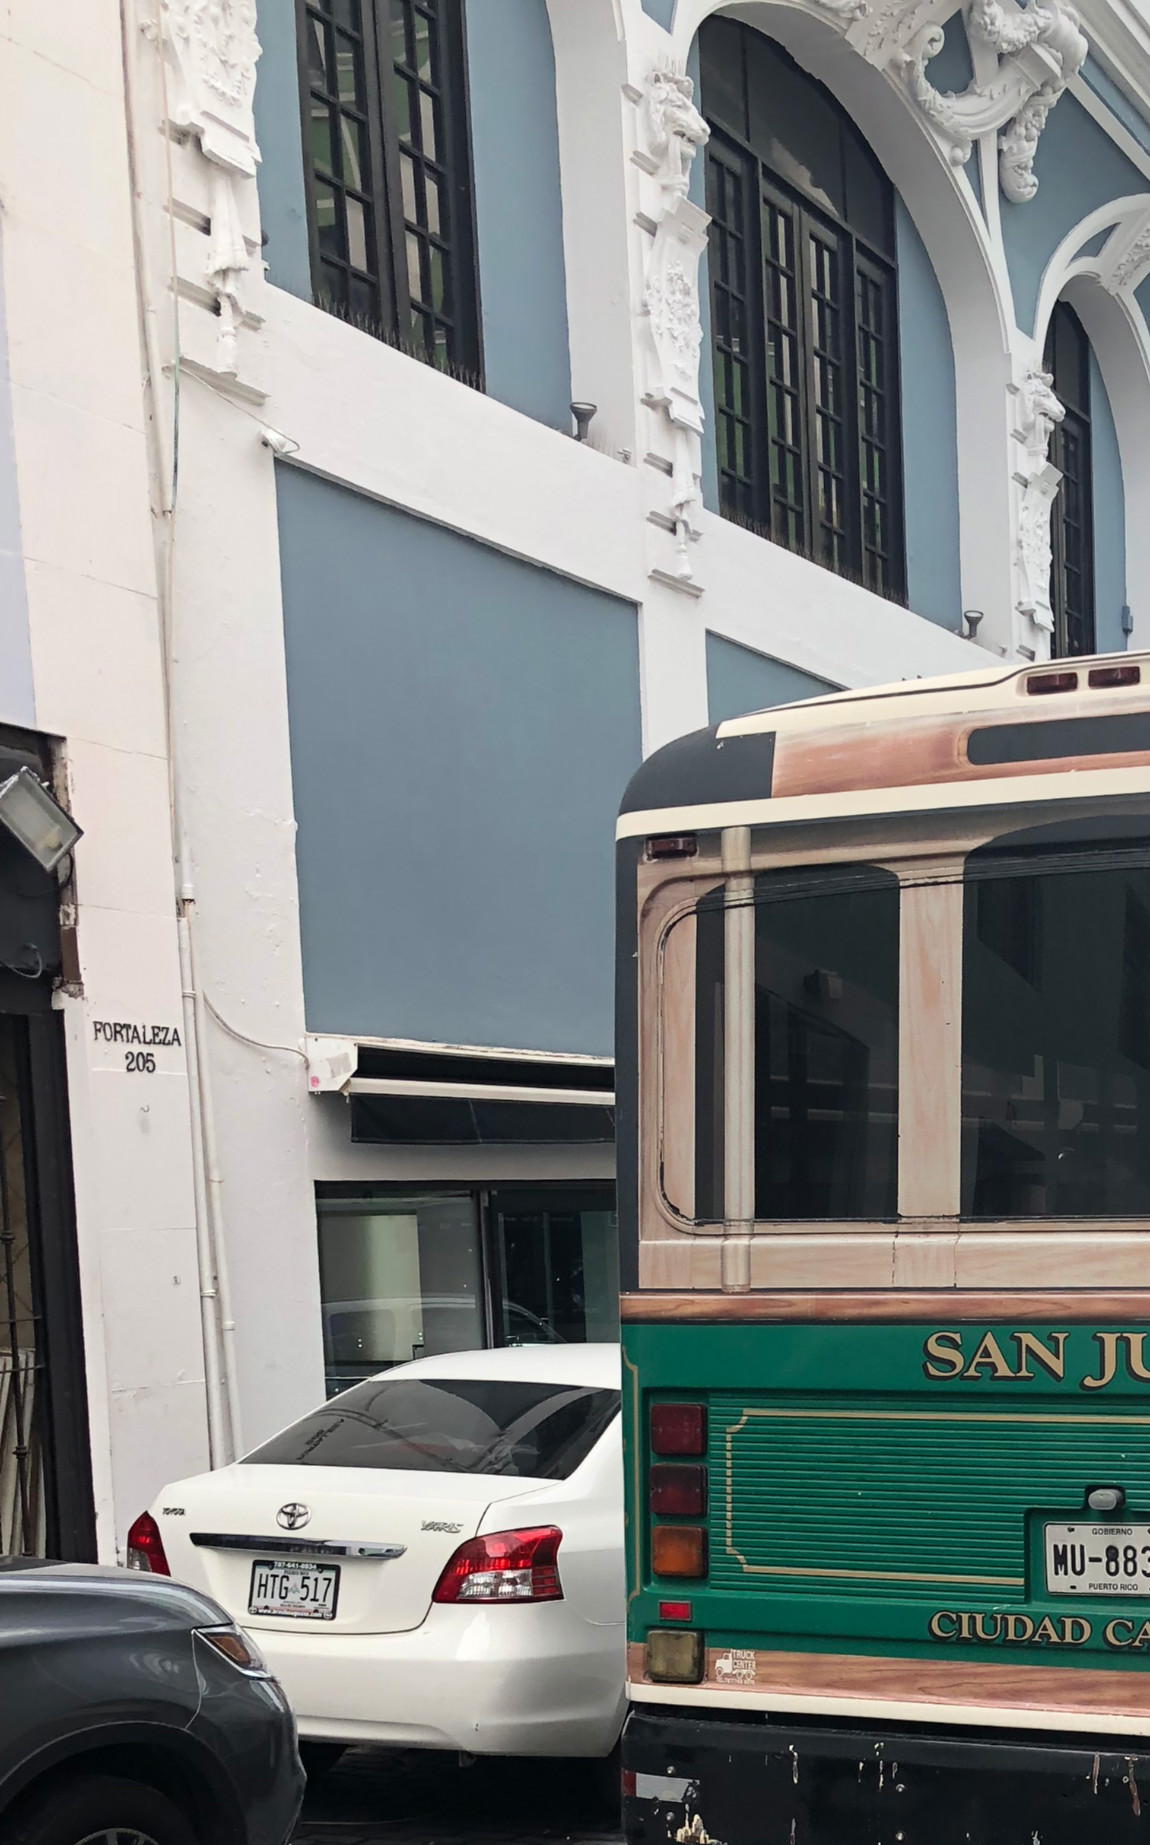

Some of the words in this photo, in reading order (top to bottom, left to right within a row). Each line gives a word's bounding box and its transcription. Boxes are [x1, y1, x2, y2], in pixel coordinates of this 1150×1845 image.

[92, 1020, 182, 1047] FORTALEZA
[125, 1051, 156, 1073] 205
[923, 1330, 1070, 1383] SAN
[162, 1507, 185, 1516] TOYOTA
[1092, 1528, 1133, 1536] GOBIERNO
[257, 1573, 290, 1600] HTG
[300, 1576, 332, 1603] 517
[1089, 1583, 1119, 1591] PUERTO
[928, 1611, 1092, 1647] CIUDAD
[732, 1650, 755, 1660] TRUCK
